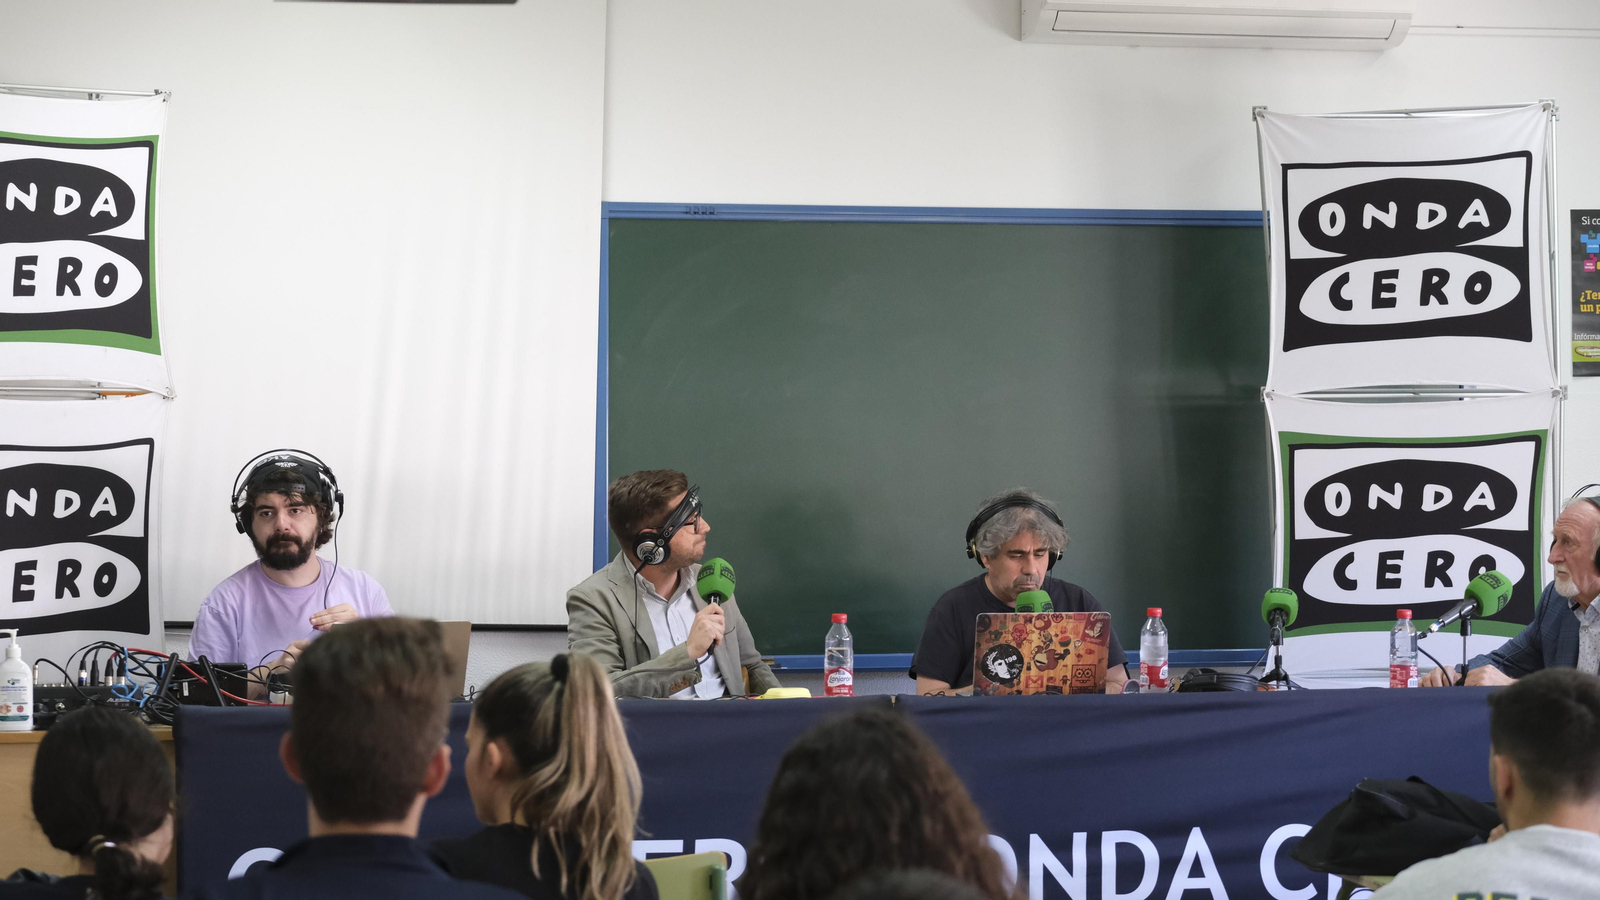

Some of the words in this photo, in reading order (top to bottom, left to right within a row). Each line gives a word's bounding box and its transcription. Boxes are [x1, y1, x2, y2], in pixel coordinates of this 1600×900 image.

[1318, 198, 1490, 237] ONDA
[1581, 216, 1590, 225] Si
[1328, 268, 1492, 311] CERO
[1324, 481, 1495, 517] ONDA
[1333, 549, 1497, 591] CERO
